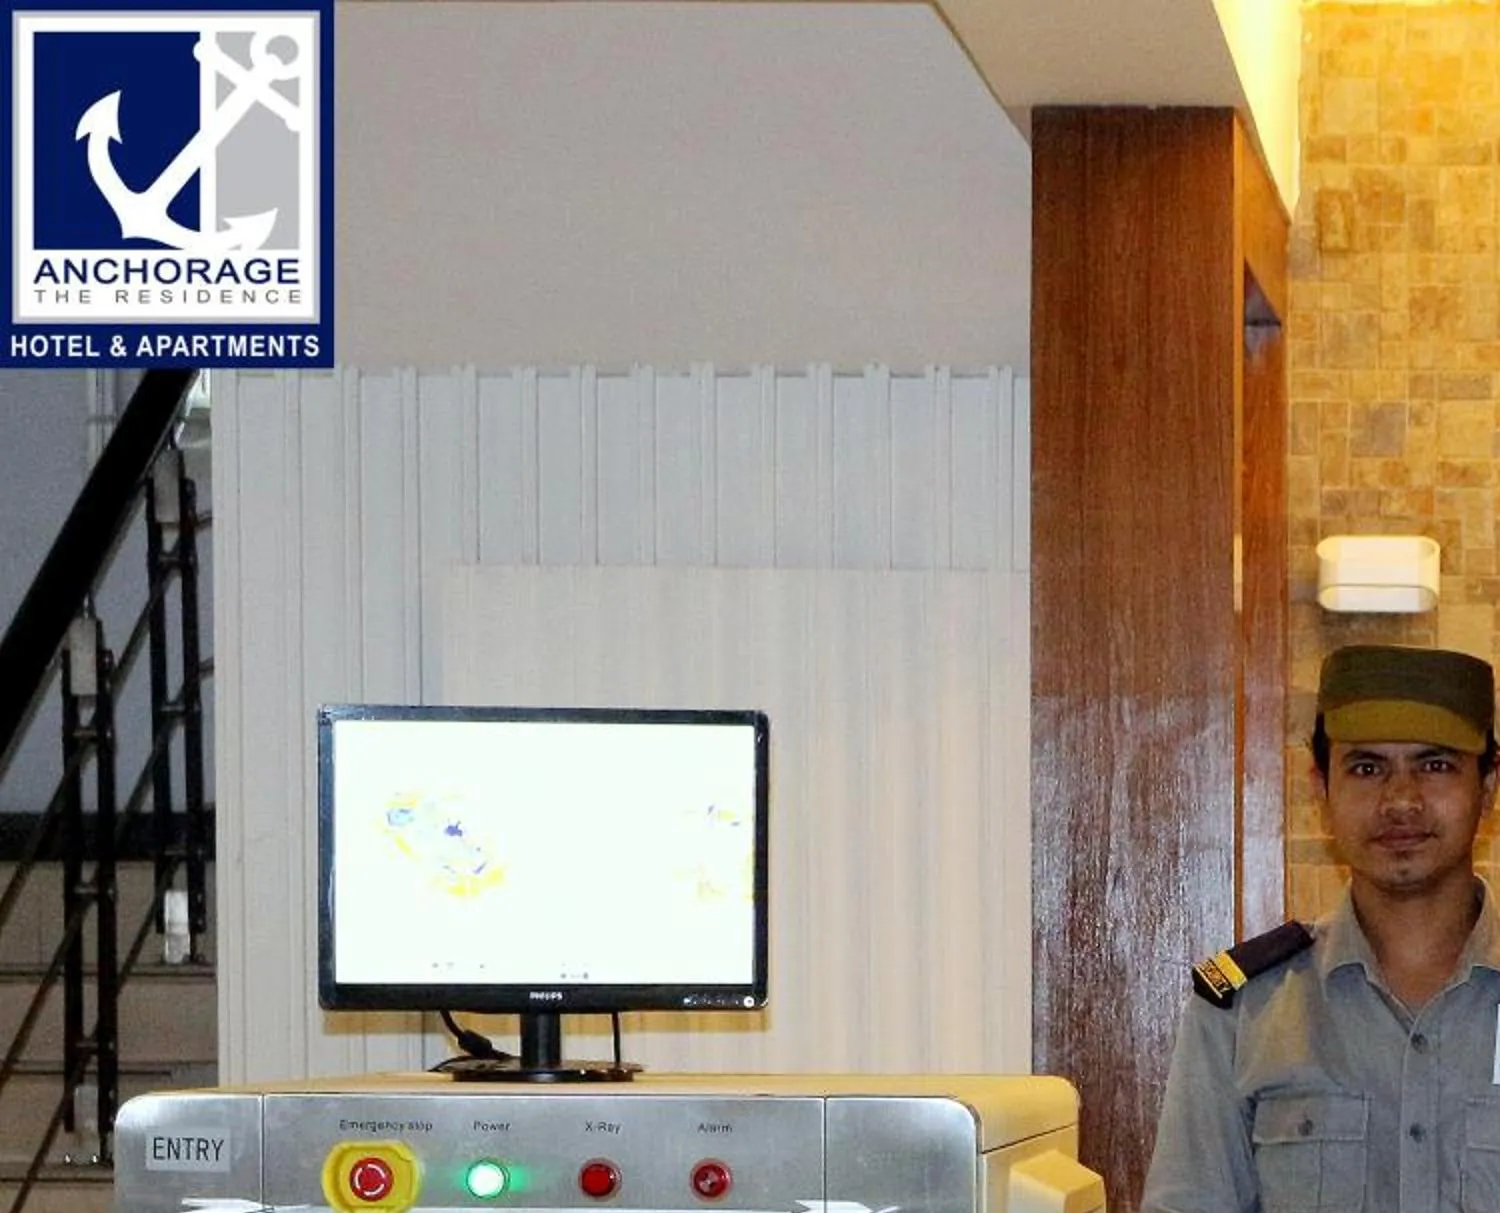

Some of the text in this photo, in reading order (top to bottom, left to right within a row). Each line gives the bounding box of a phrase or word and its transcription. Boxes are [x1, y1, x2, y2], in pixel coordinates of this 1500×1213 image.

[473, 1120, 511, 1132] Power
[697, 1122, 732, 1133] Alarm
[152, 1137, 225, 1161] ENTRY
